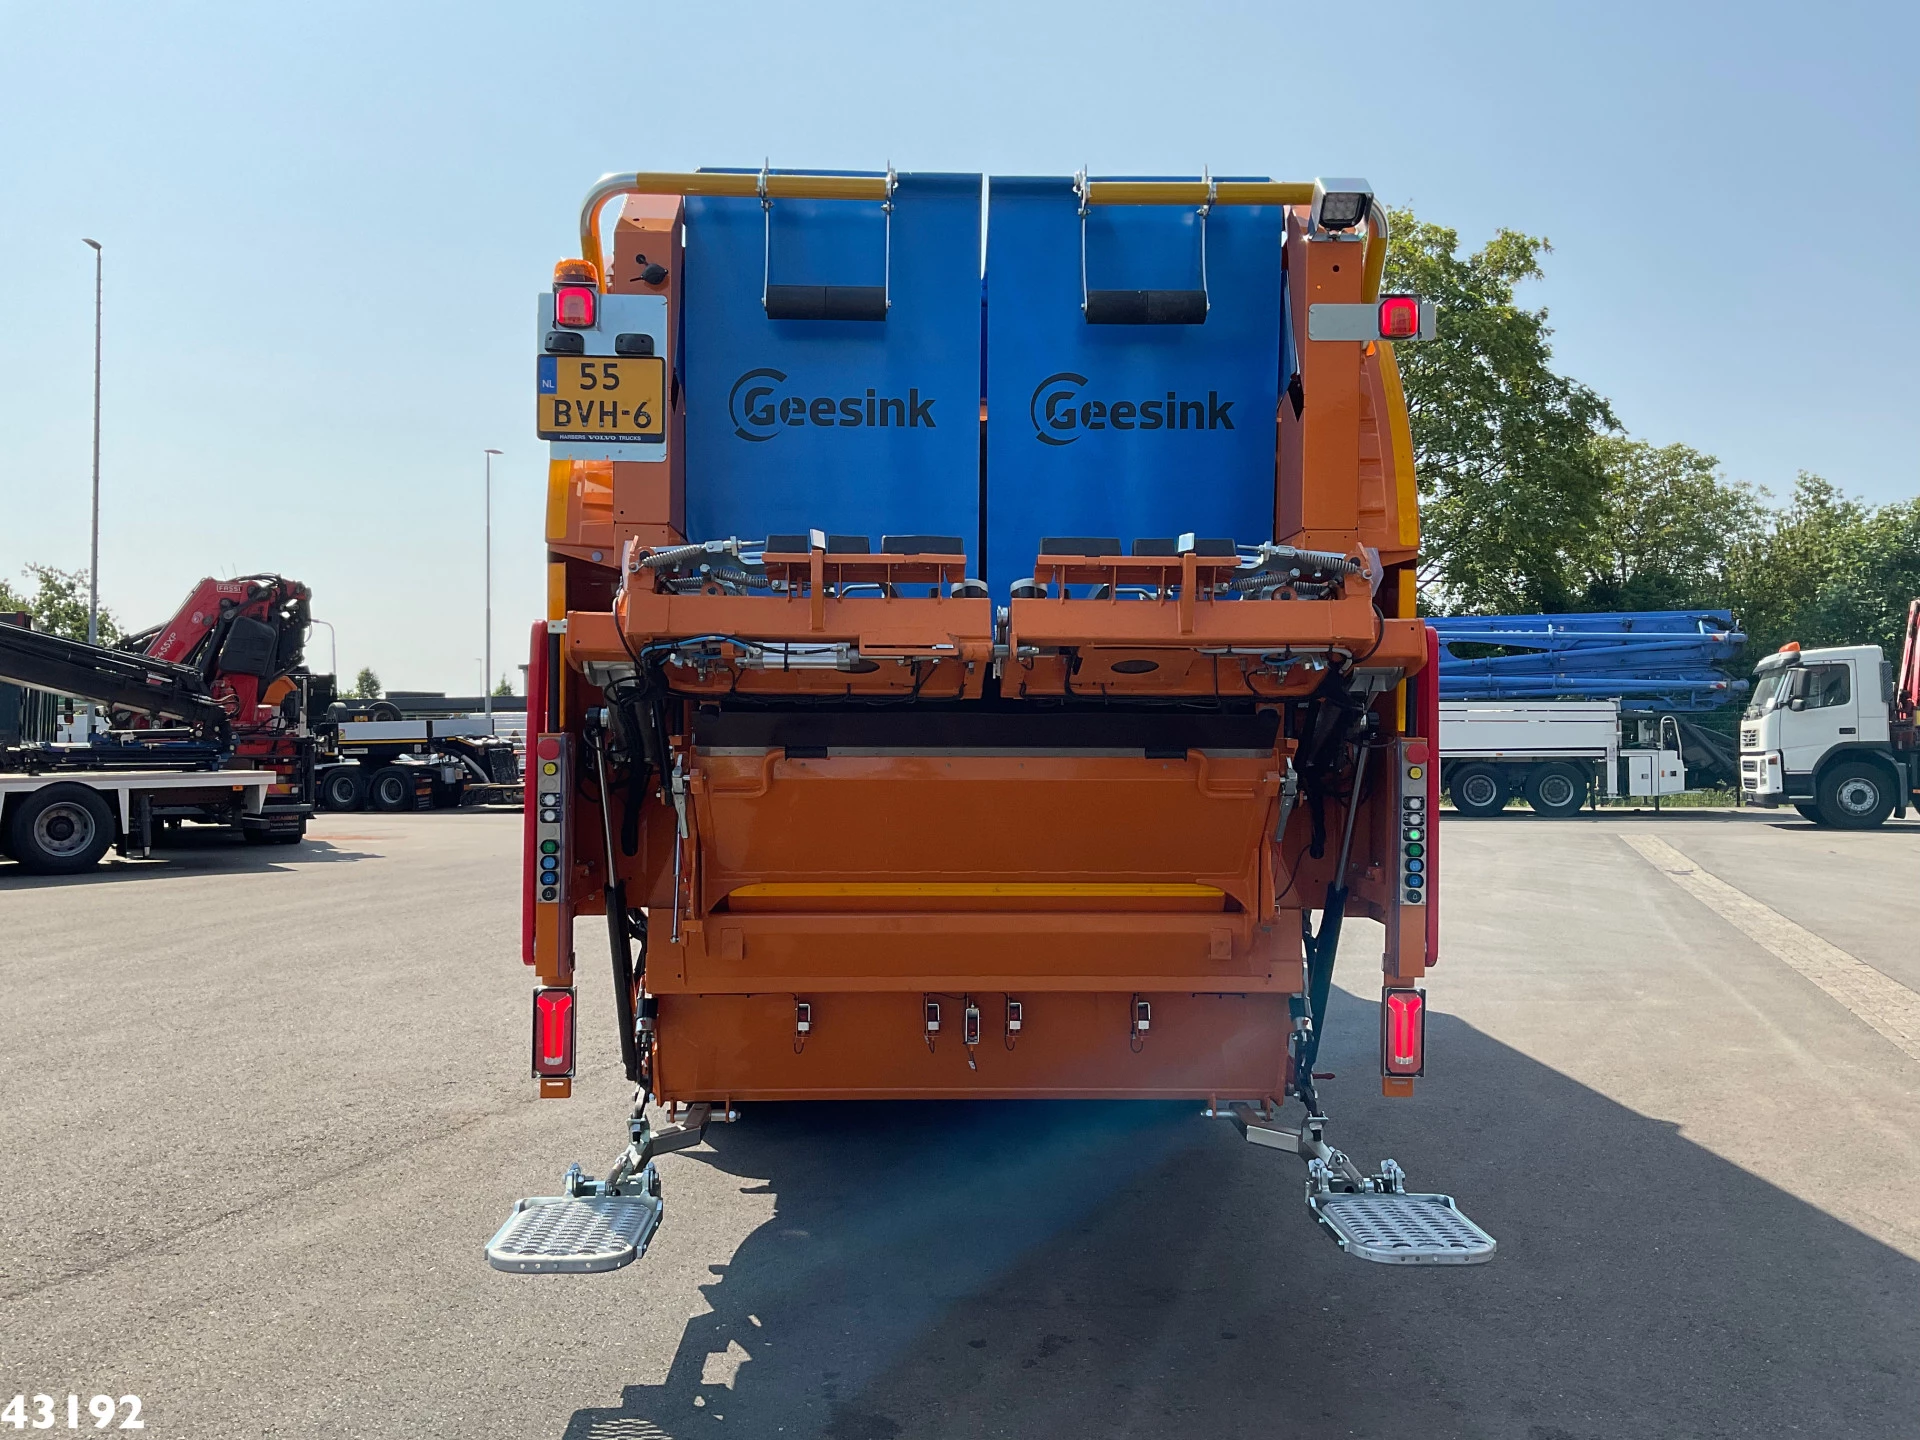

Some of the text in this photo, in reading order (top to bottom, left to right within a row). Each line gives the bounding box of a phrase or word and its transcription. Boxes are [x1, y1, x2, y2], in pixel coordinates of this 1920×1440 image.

[542, 379, 555, 389] NL
[580, 362, 620, 391] 55
[554, 399, 652, 429] BVH-6
[728, 367, 937, 442] Geesink
[1030, 371, 1236, 446] Geesink
